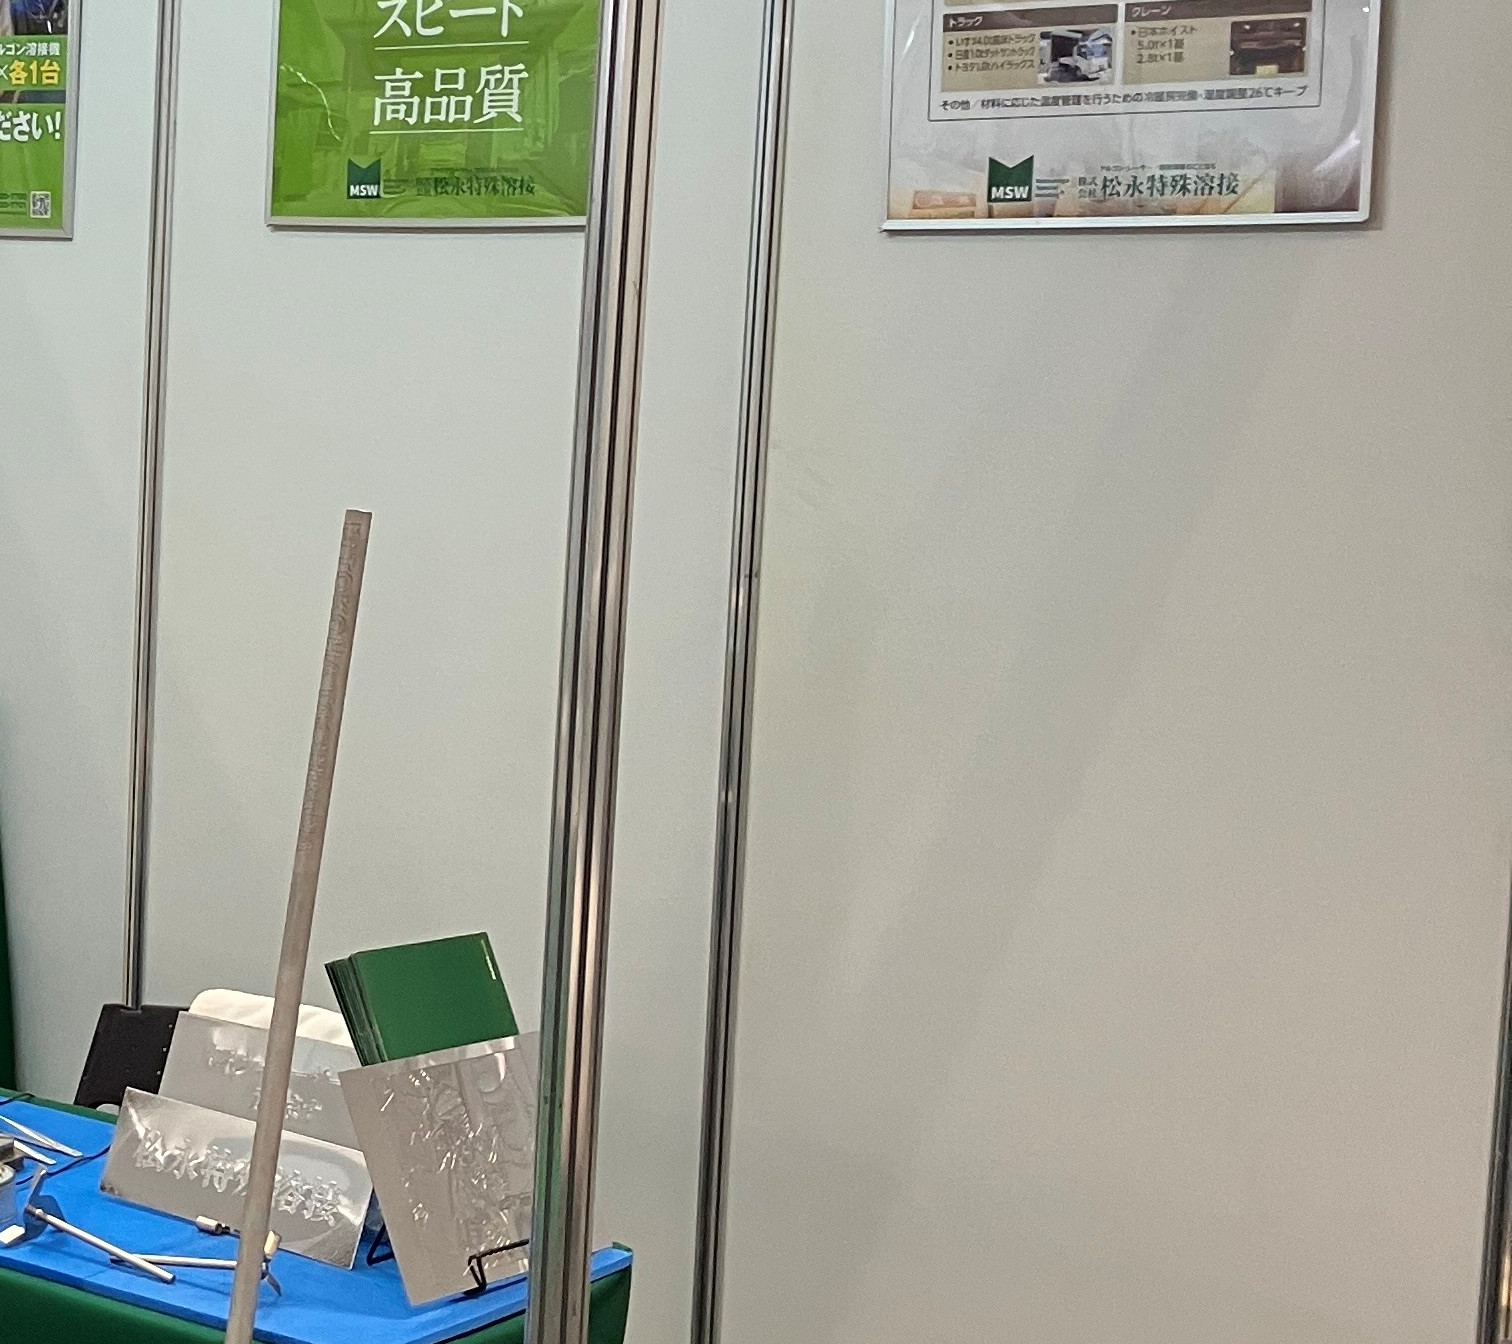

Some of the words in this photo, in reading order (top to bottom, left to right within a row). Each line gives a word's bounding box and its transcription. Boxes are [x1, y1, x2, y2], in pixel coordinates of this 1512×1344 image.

[373, 63, 529, 125] 高品質
[349, 184, 379, 197] MSW
[991, 185, 1029, 200] MSW
[1101, 173, 1240, 199] 松永特殊溶接
